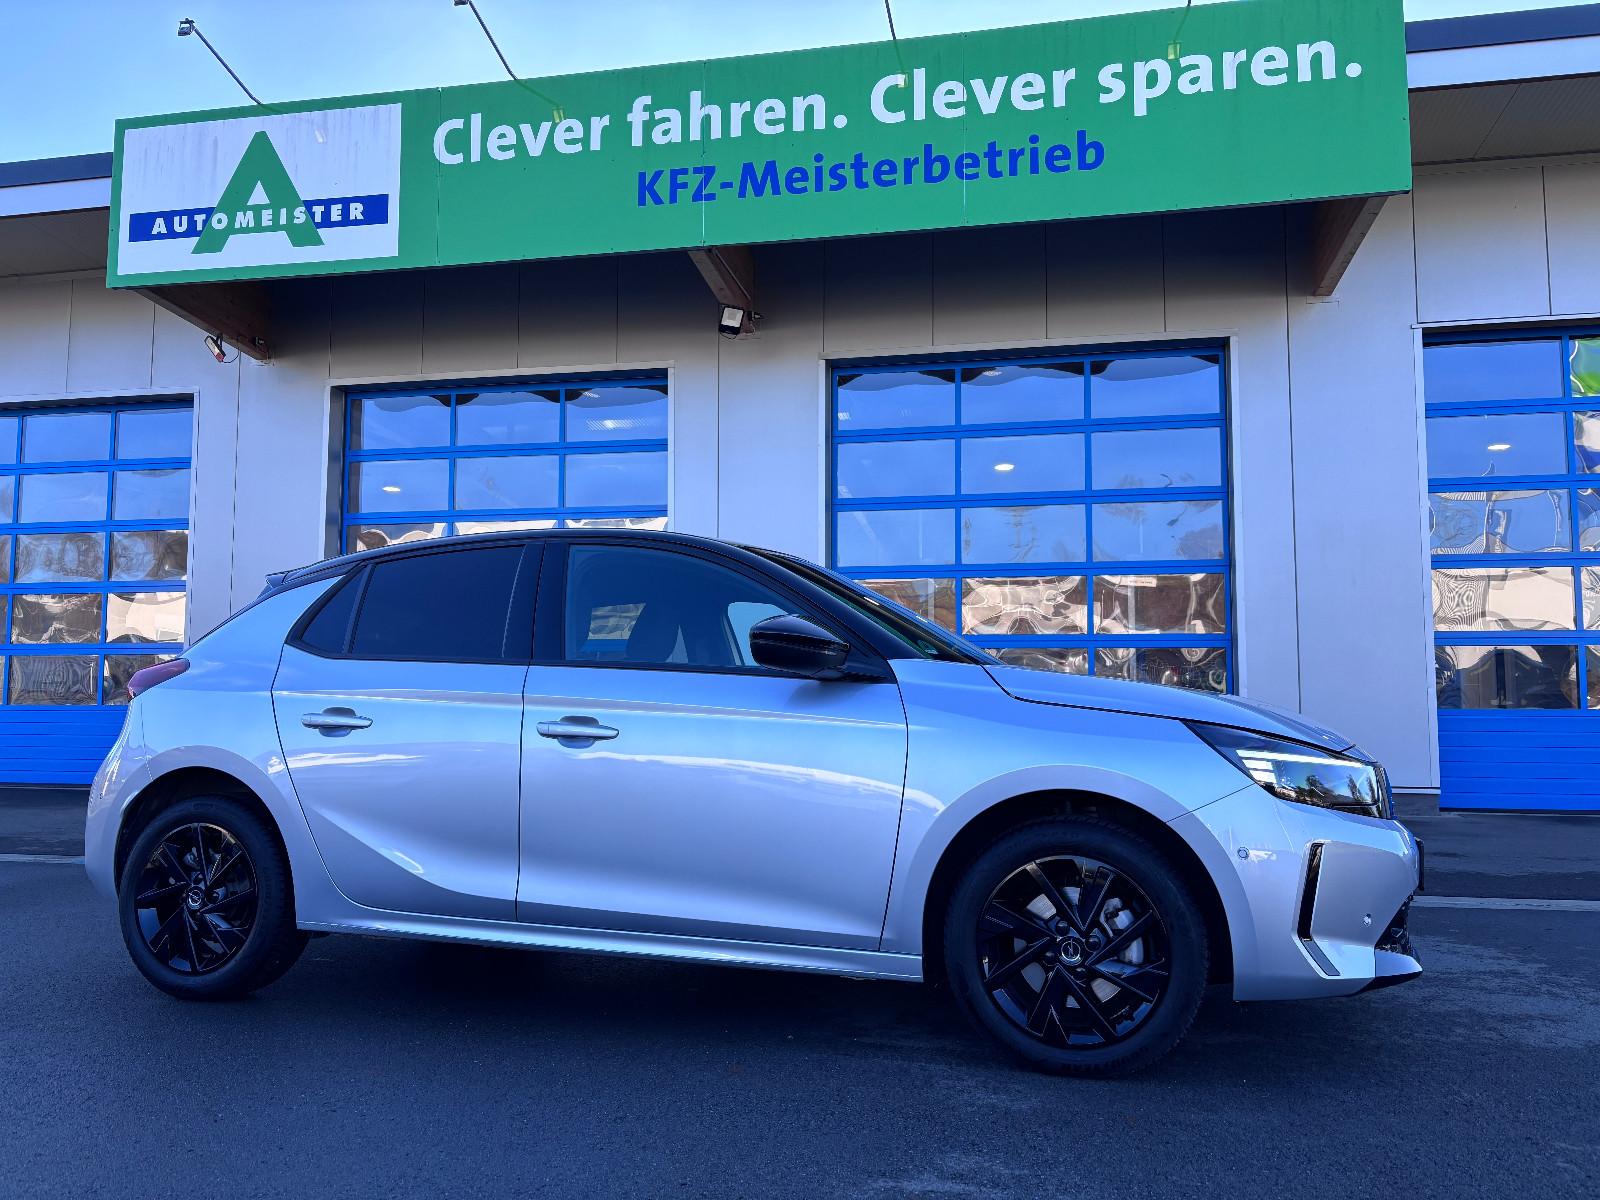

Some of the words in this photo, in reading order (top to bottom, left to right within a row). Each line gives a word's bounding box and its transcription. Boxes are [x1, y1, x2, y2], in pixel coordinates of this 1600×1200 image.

[433, 113, 610, 165] Clever
[627, 91, 848, 147] fahren.
[870, 67, 1076, 124] Clever
[1097, 40, 1363, 117] sparen.
[151, 202, 365, 235] AUTOMEISTER
[190, 130, 325, 255] A
[637, 130, 1106, 207] KFZ-Meisterbetrieb
